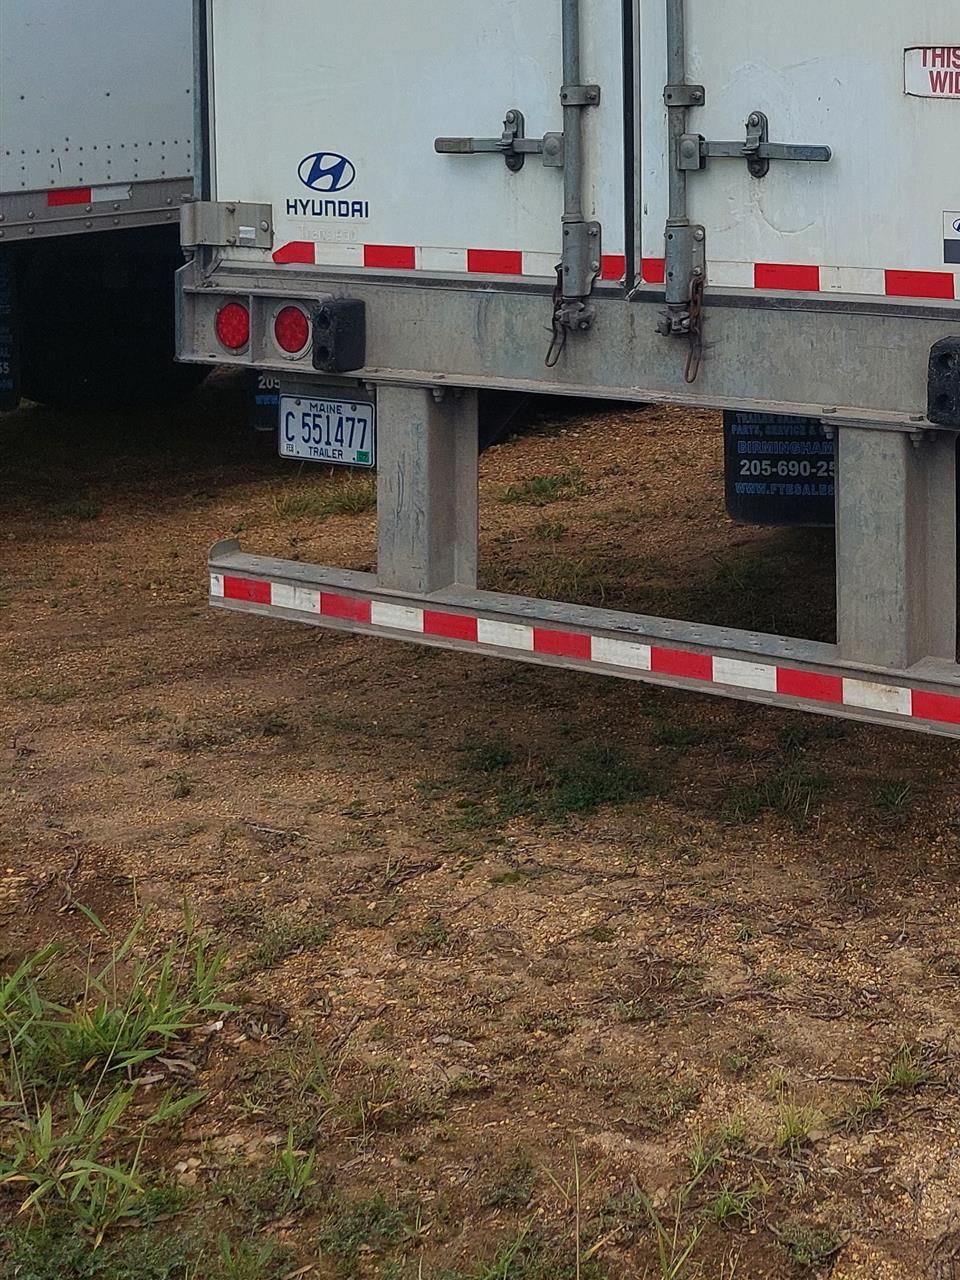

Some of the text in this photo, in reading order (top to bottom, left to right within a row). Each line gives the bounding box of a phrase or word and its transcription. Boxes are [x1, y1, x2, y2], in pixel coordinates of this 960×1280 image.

[286, 199, 369, 218] HYUNDAI
[309, 402, 343, 415] MAINE
[285, 411, 368, 450] C 551477
[308, 445, 344, 460] TRAILER
